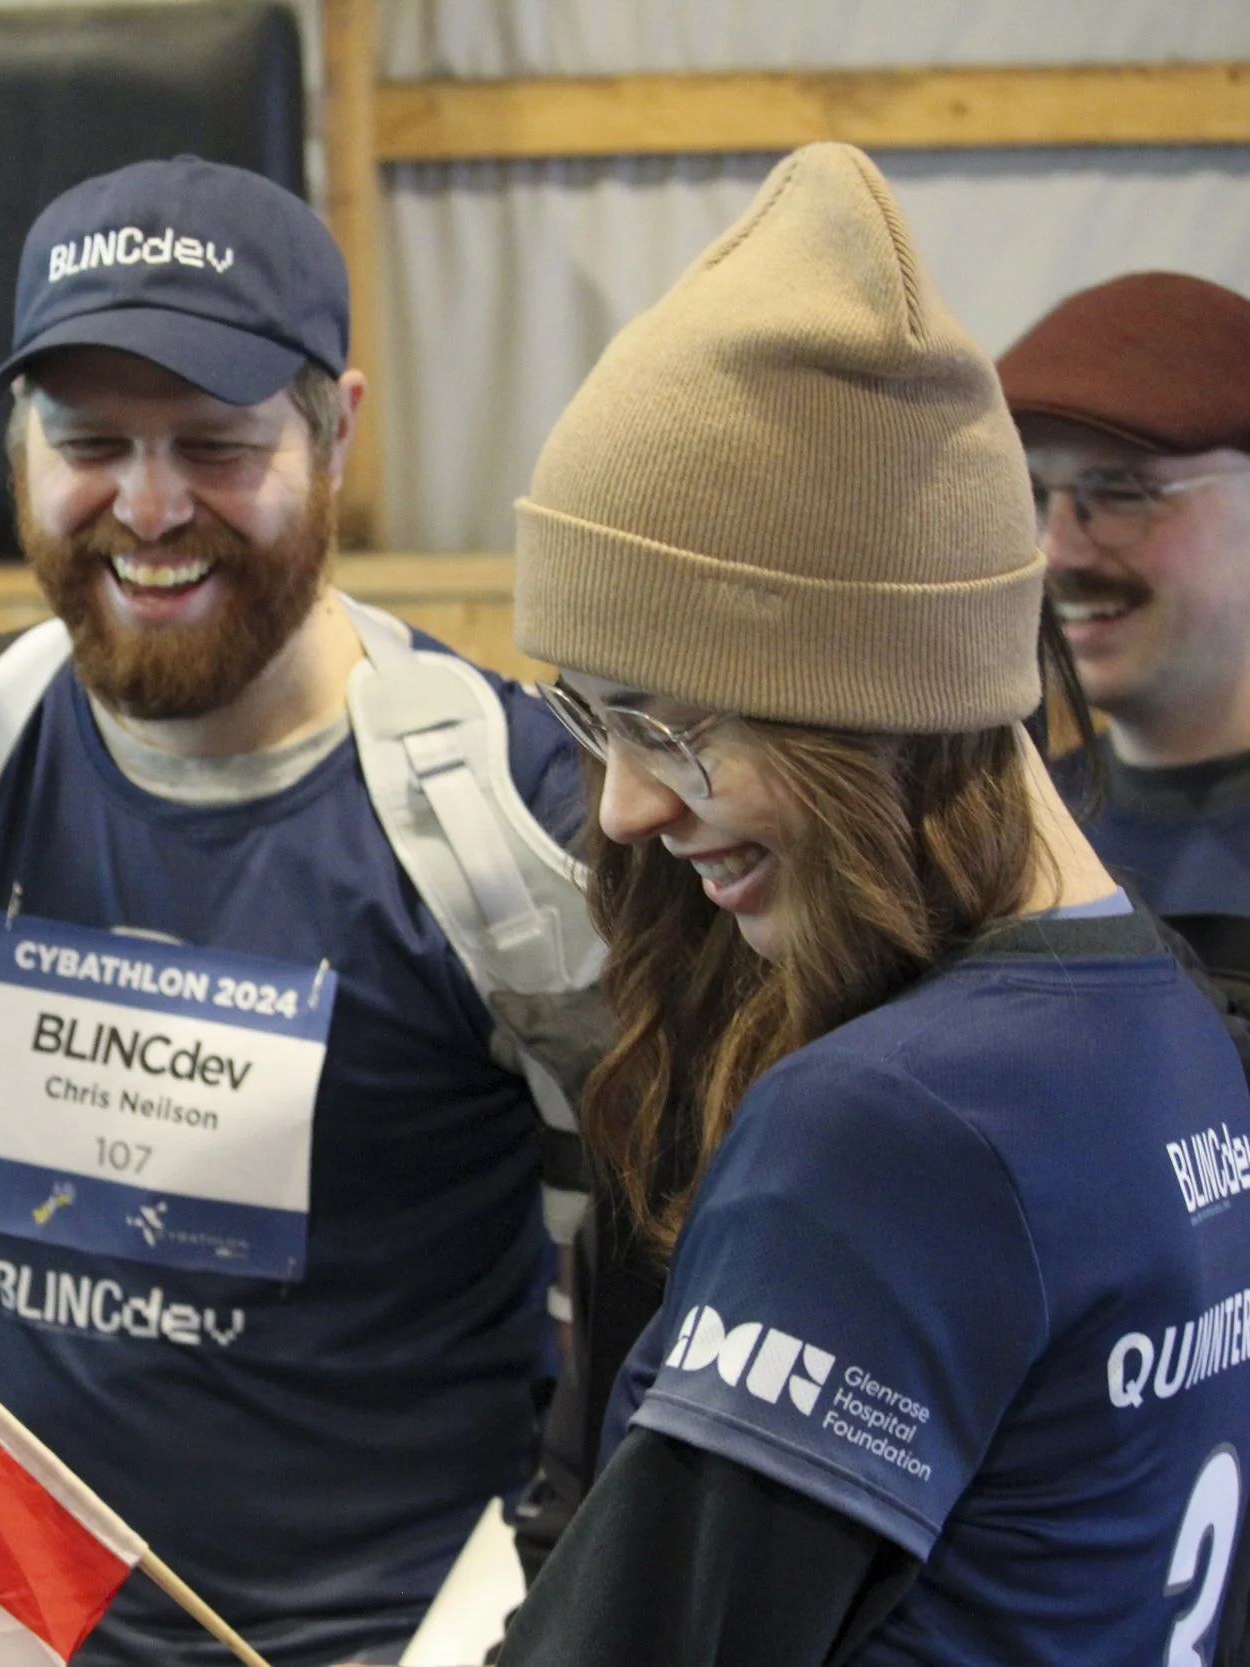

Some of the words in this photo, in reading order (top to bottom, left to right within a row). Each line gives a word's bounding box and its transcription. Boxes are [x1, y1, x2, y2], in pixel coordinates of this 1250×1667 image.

[48, 226, 234, 283] BLINCdev
[14, 940, 209, 1003] CYBATHLON
[212, 977, 298, 1020] 2024
[31, 1011, 253, 1091] BLINCdev
[44, 1075, 111, 1110] Chris
[118, 1094, 219, 1131] Neilson
[94, 1136, 154, 1175] 107
[832, 1388, 917, 1444] Hospital
[843, 1365, 931, 1424] Glenrose
[821, 1411, 932, 1482] Foundation
